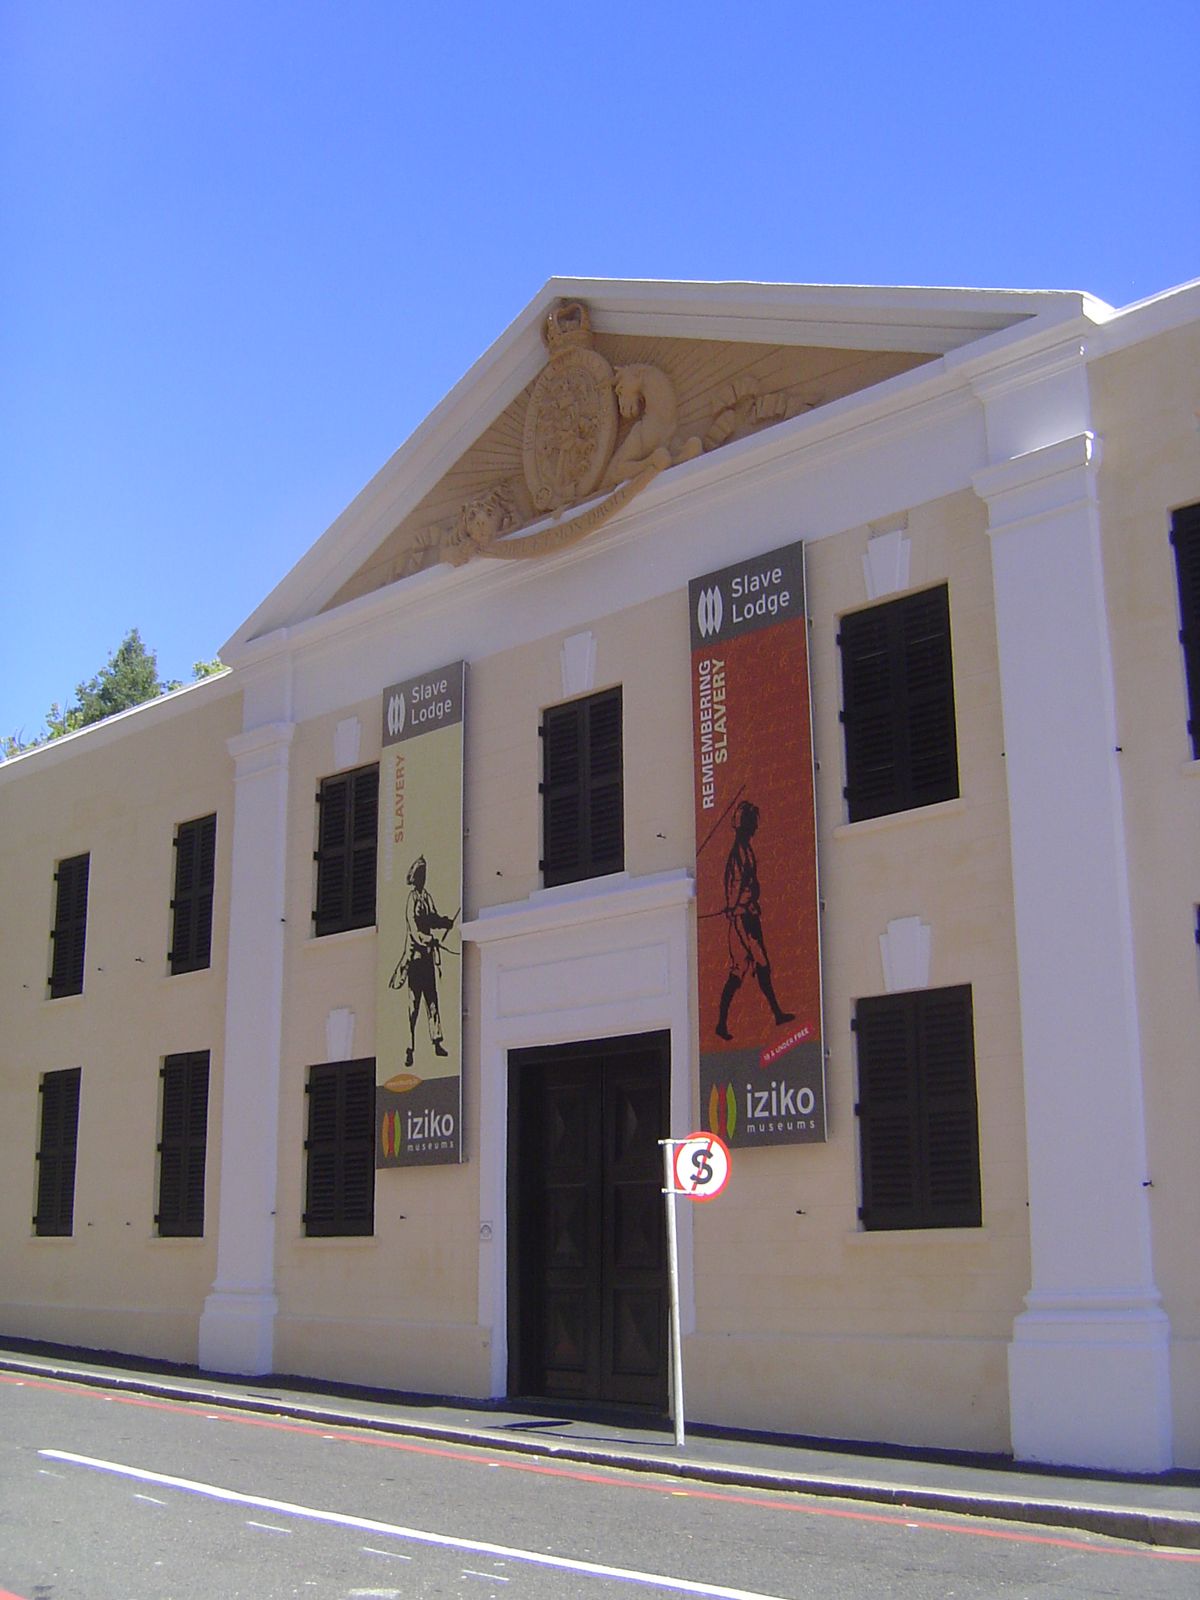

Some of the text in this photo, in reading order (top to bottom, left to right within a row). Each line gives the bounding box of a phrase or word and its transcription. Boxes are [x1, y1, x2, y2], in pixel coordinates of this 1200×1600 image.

[731, 568, 782, 598] Slave
[732, 591, 790, 623] Lodge
[411, 679, 448, 703] Slave
[411, 699, 452, 725] Lodge
[712, 658, 728, 764] SLAVERY
[699, 660, 715, 809] REMEMBERING
[394, 755, 406, 843] SLAVERY
[775, 1037, 794, 1054] UNDER
[794, 1027, 810, 1041] FREE
[747, 1080, 815, 1118] iziko
[407, 1109, 454, 1139] iziko
[747, 1120, 815, 1133] museums
[407, 1140, 454, 1152] museums
[690, 1149, 713, 1184] S
